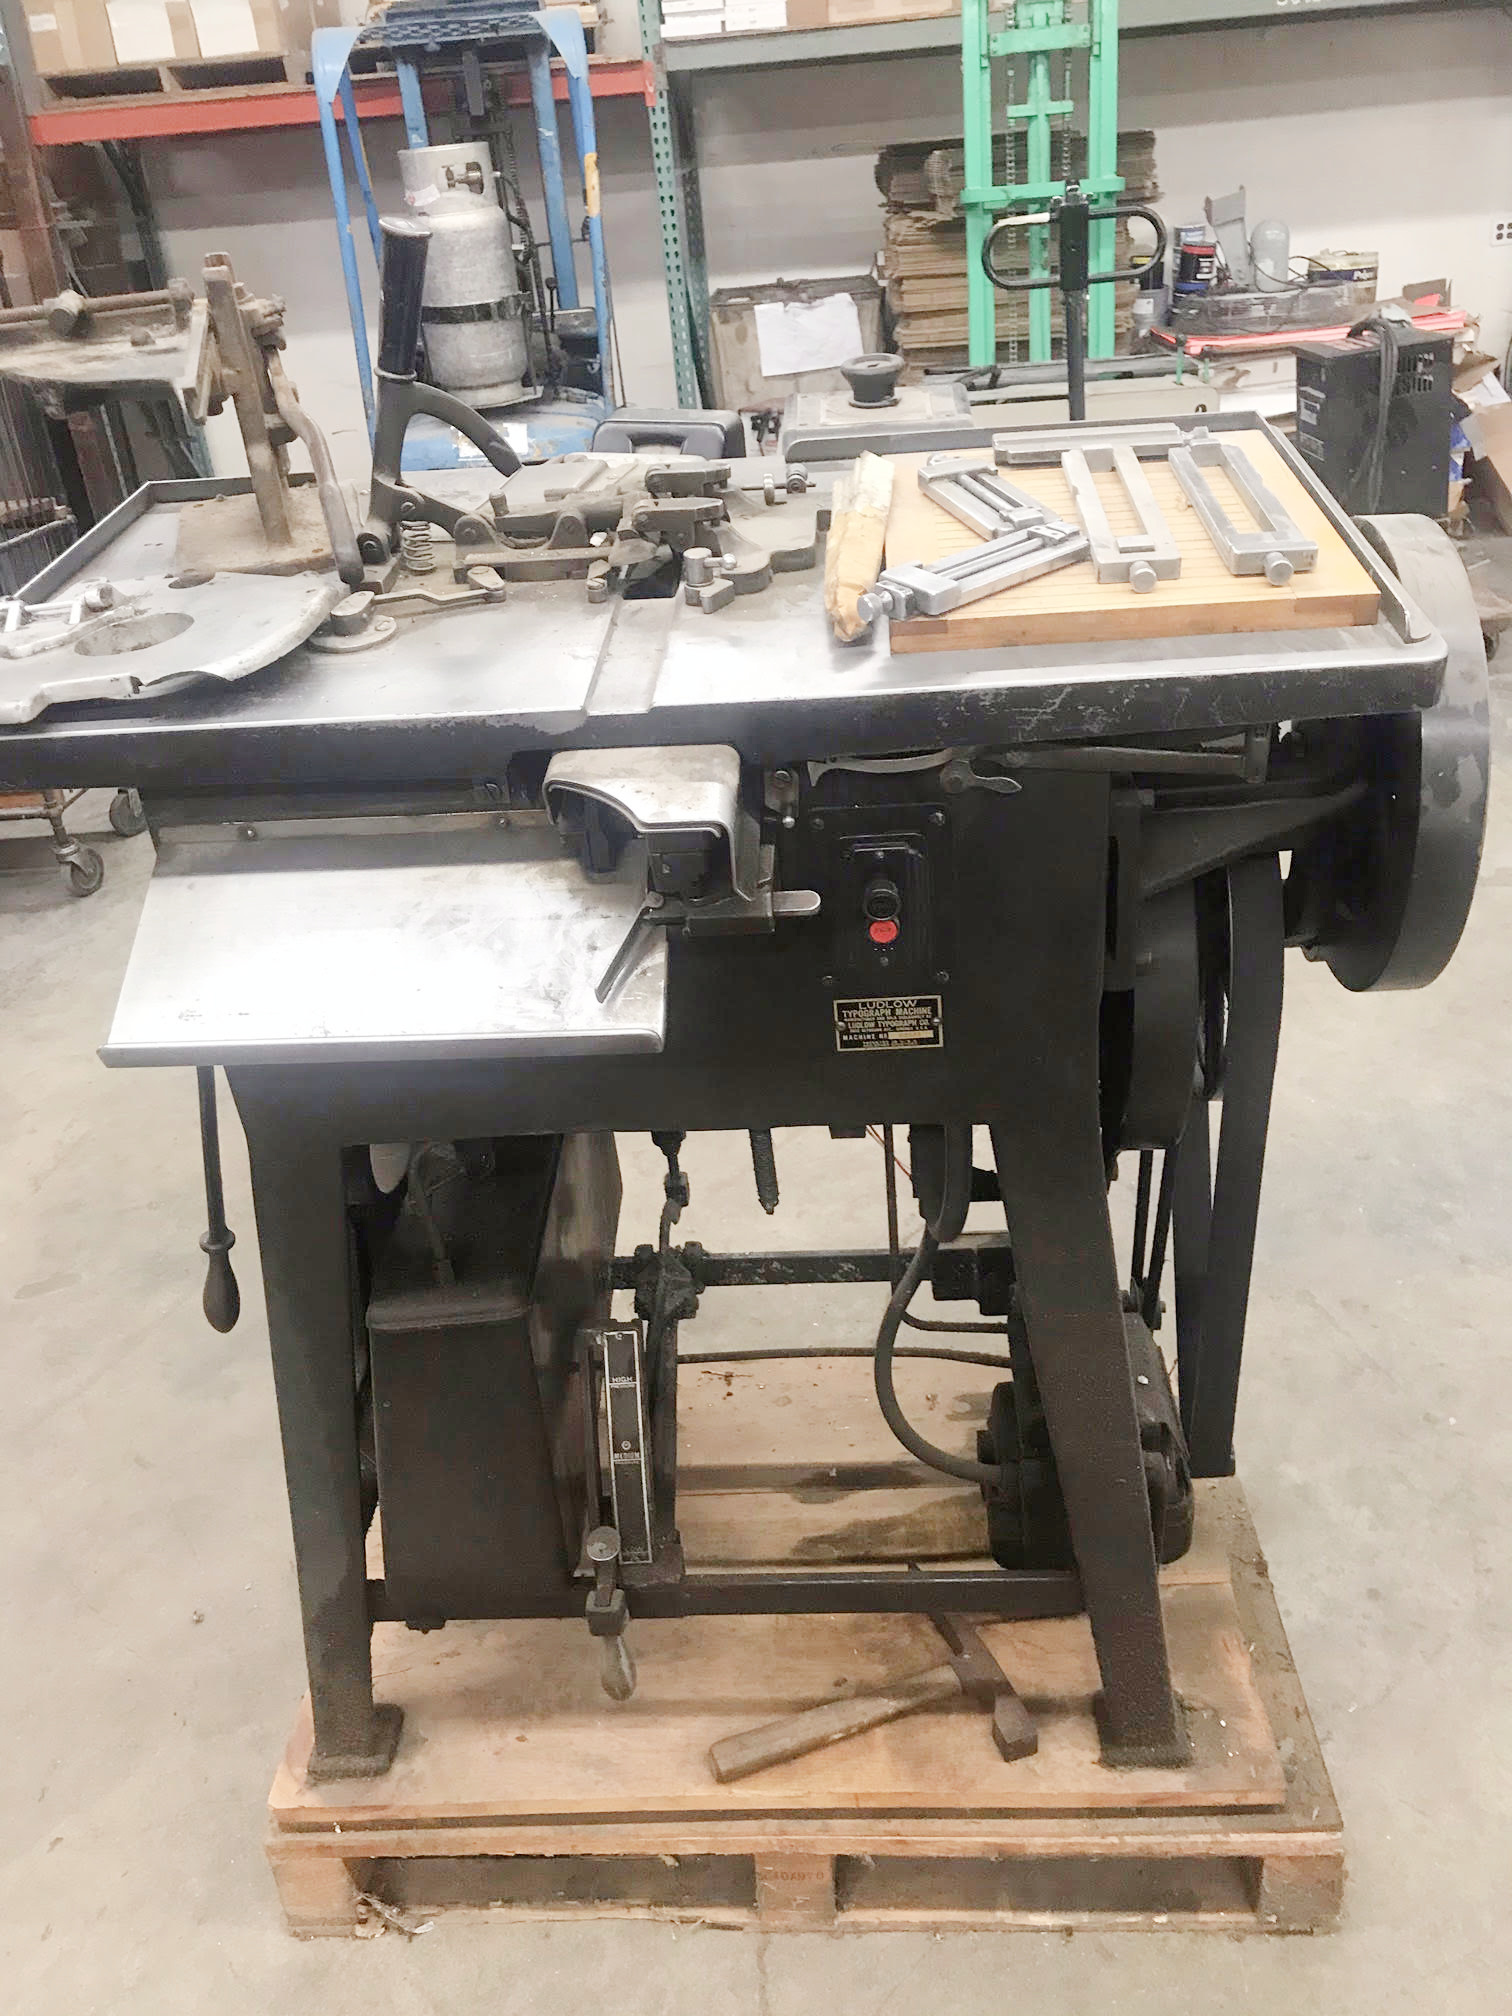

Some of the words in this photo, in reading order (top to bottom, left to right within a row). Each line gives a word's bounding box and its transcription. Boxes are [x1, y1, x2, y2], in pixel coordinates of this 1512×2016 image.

[858, 1000, 918, 1009] LUDLOW
[842, 1008, 892, 1018] TYPOGRAPH
[895, 1006, 932, 1015] MACHINE
